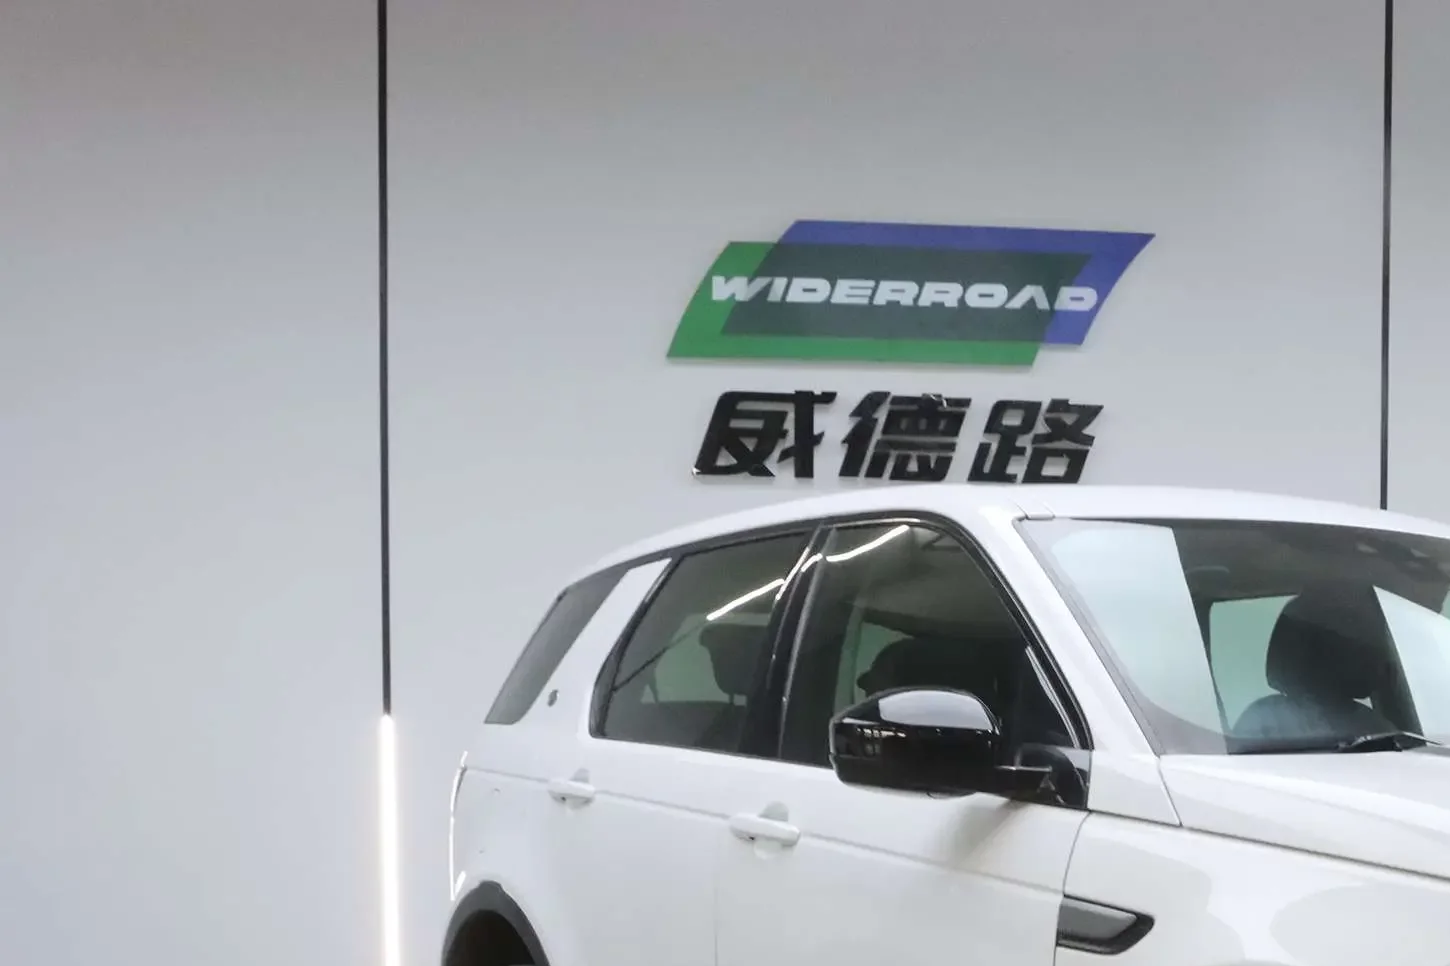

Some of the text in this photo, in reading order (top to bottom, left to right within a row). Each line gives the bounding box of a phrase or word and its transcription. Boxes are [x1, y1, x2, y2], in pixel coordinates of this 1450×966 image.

[711, 275, 1098, 311] WIDERROAD
[692, 390, 1104, 484] 威德路
